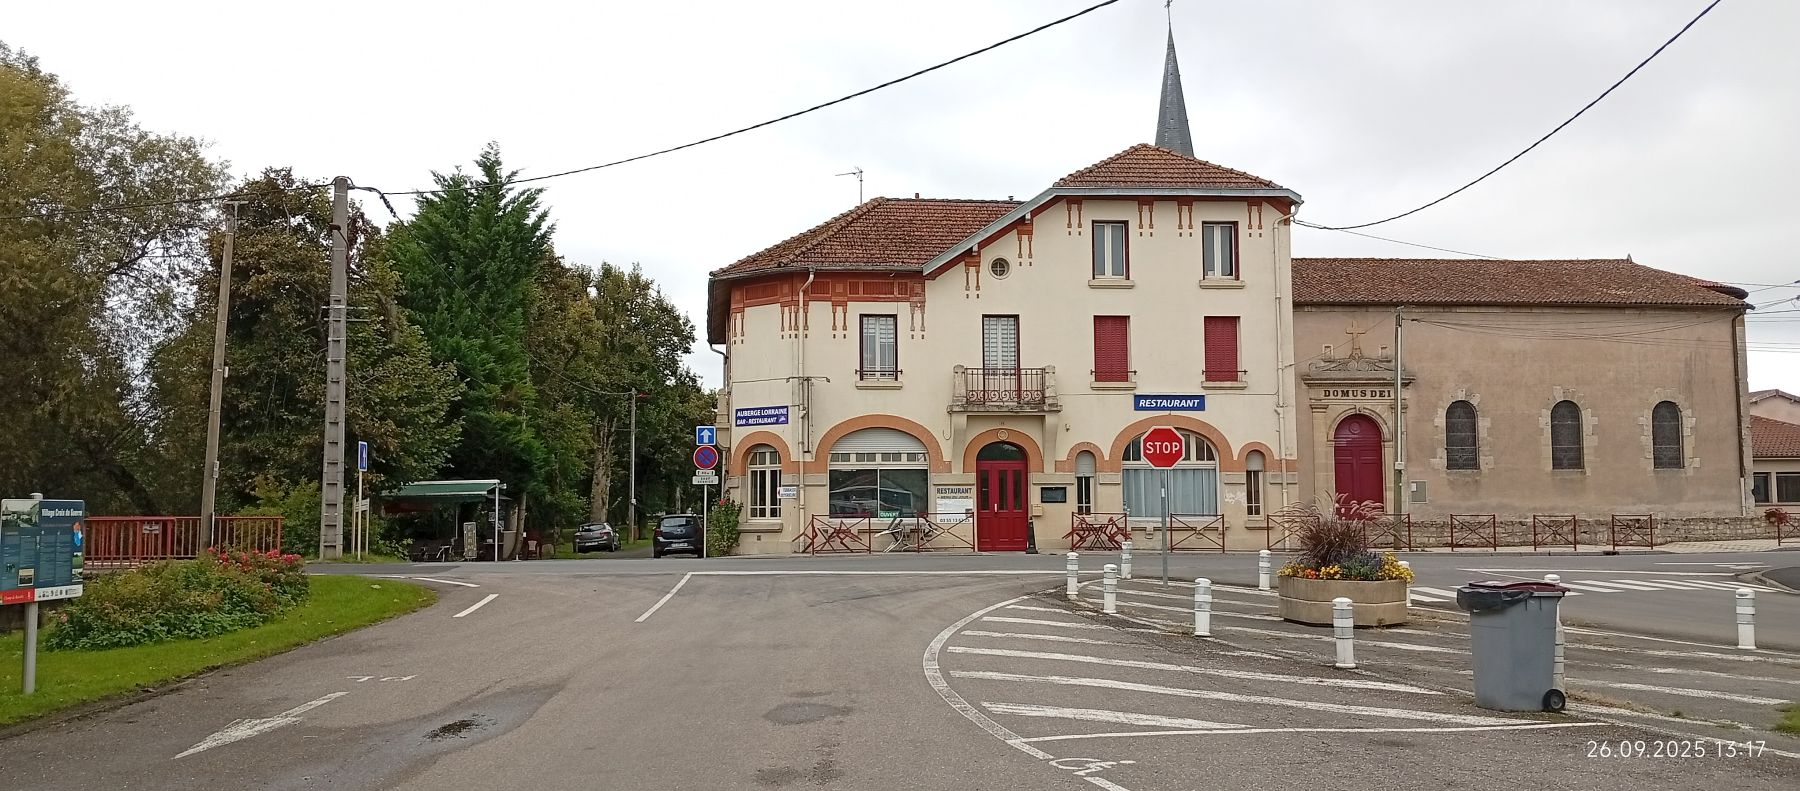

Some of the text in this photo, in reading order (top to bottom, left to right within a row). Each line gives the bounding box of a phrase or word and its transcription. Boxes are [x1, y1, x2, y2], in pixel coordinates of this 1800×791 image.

[1323, 389, 1391, 398] DOMUS DEI
[1139, 399, 1200, 408] RESTAURANT
[1146, 441, 1180, 454] STOP
